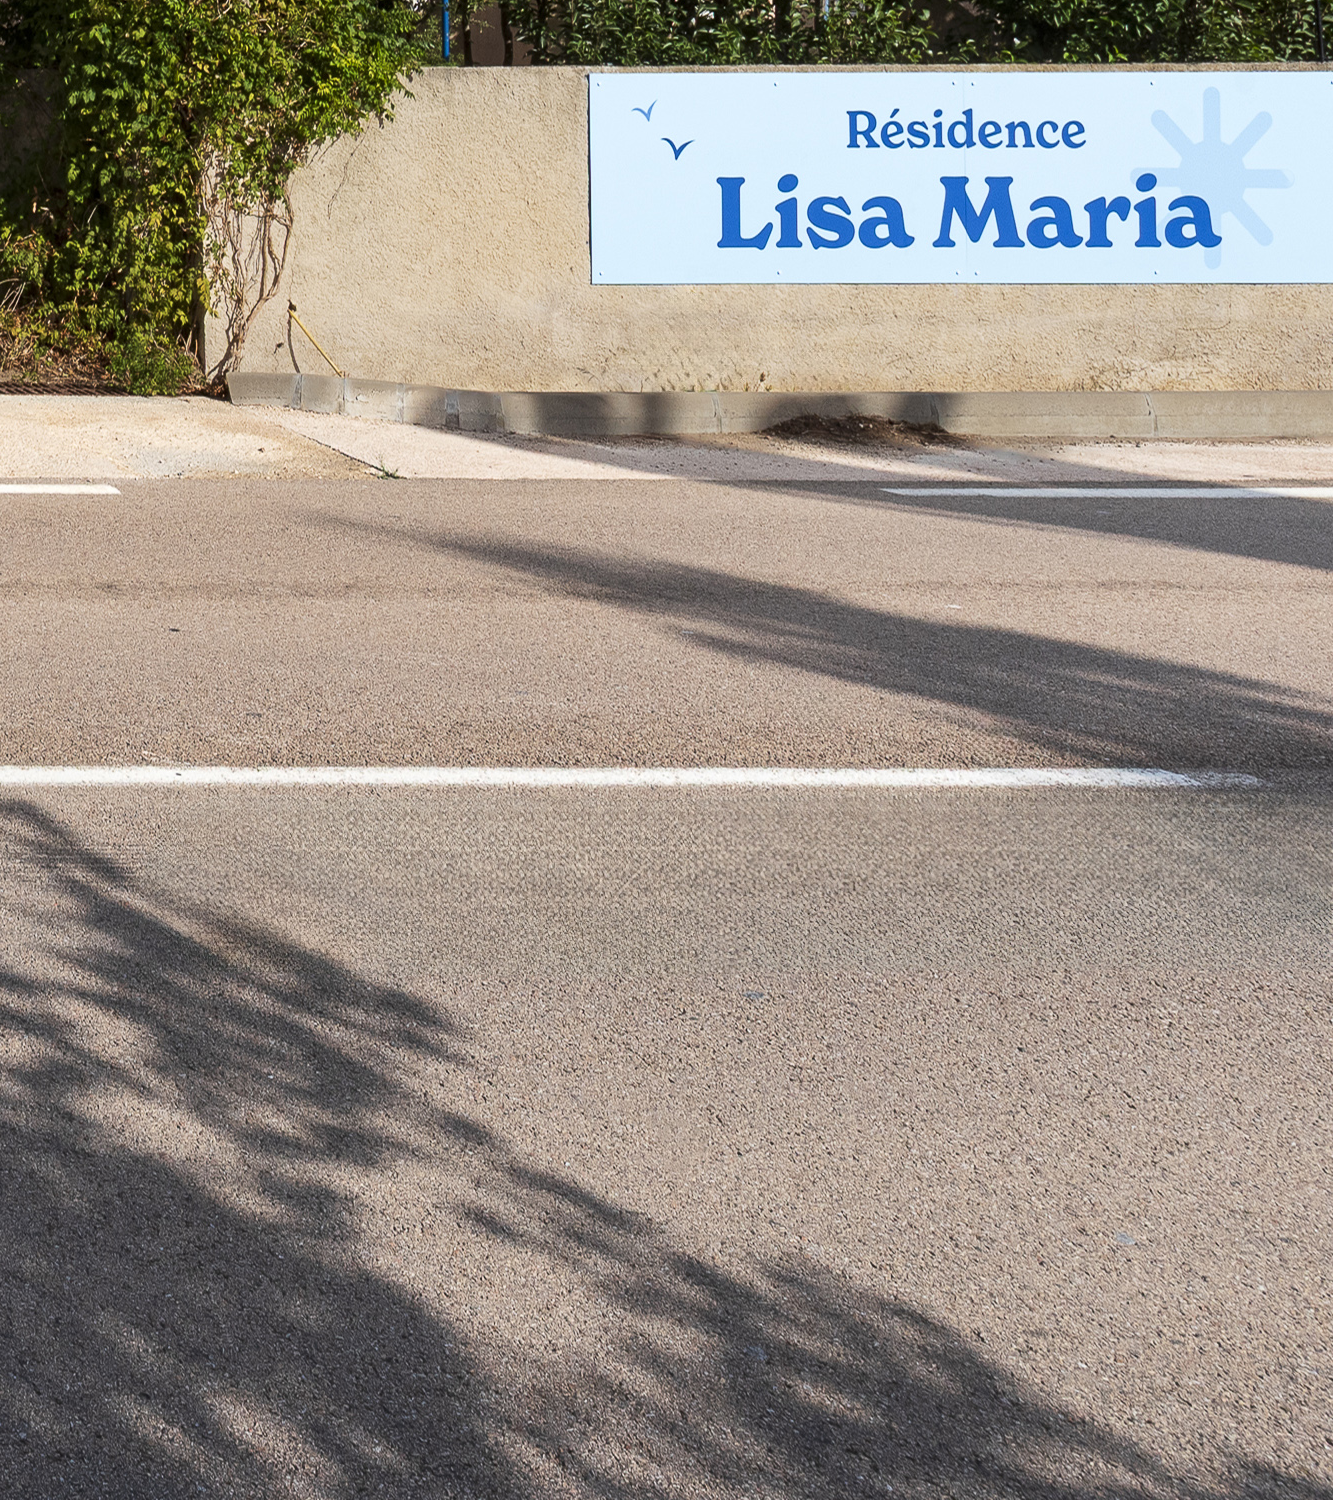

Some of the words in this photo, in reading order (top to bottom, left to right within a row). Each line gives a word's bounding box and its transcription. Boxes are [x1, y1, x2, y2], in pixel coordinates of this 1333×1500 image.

[846, 108, 1087, 150] Résidence
[717, 173, 915, 250] Lisa
[932, 173, 1222, 249] Maria
